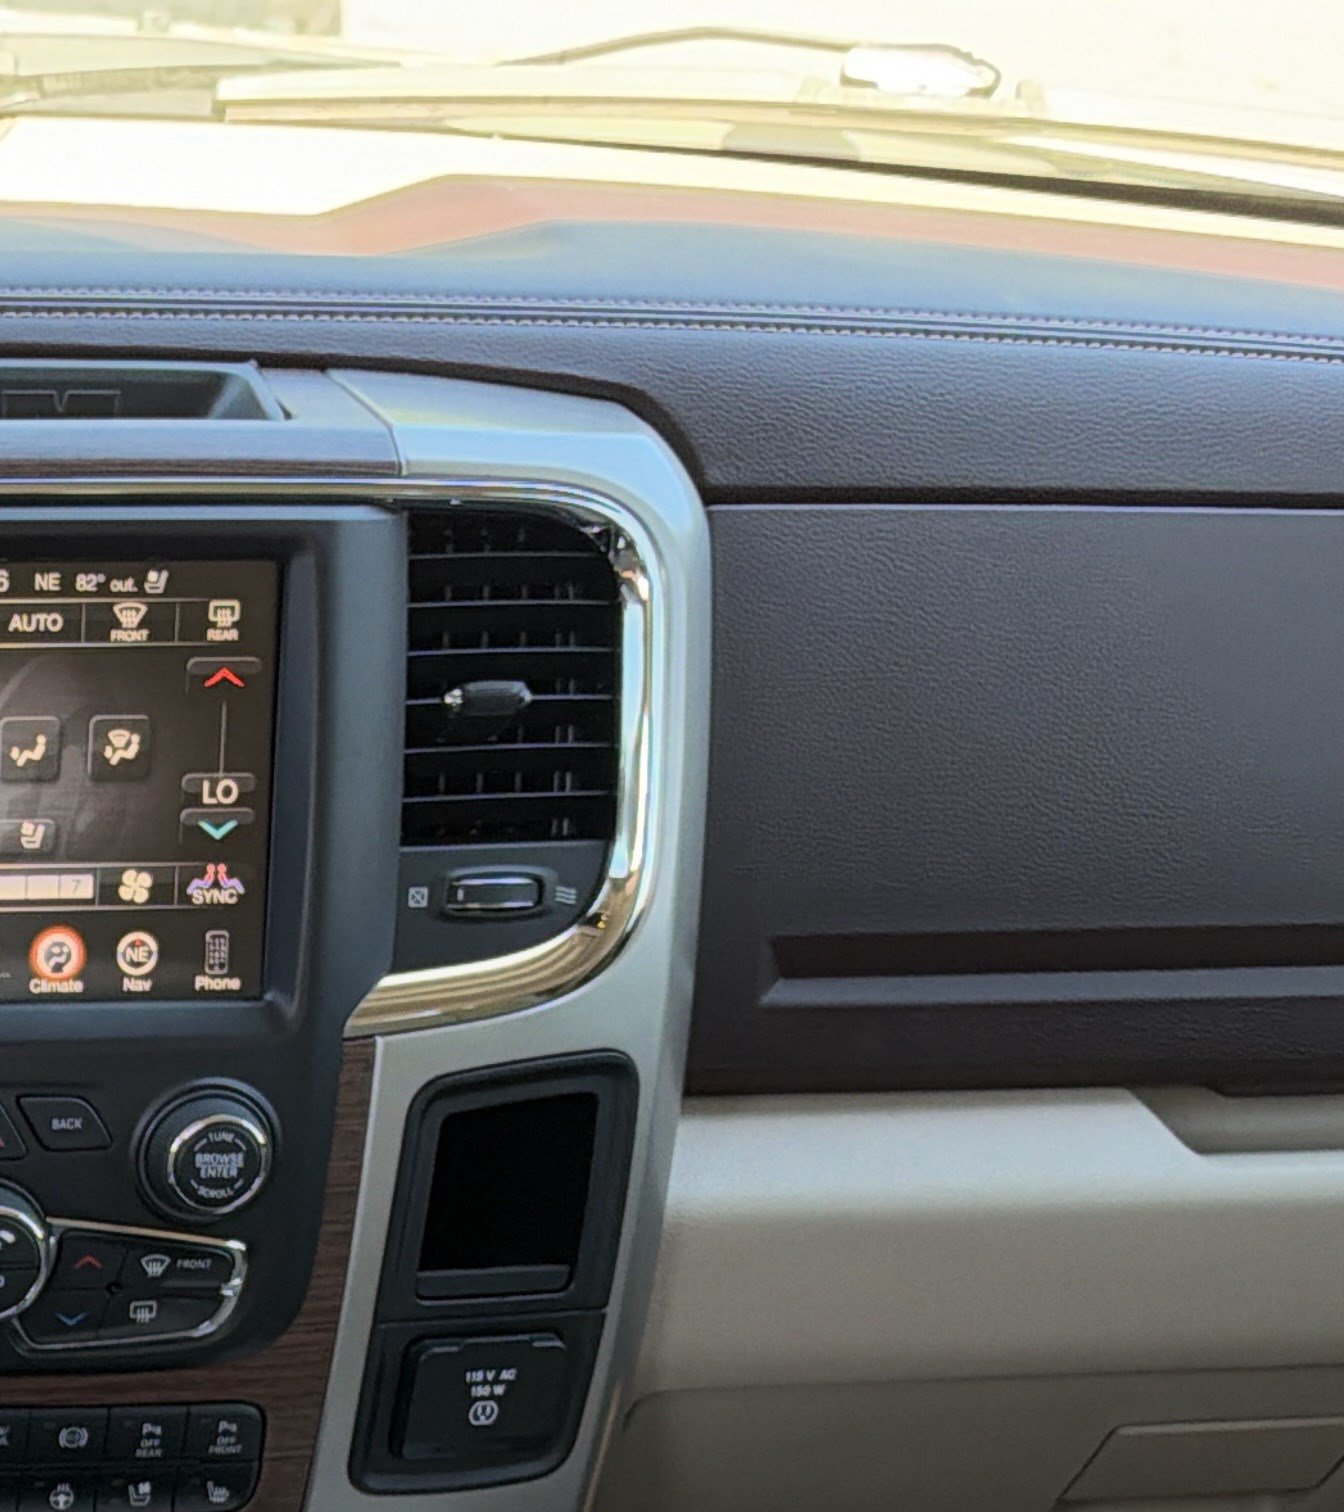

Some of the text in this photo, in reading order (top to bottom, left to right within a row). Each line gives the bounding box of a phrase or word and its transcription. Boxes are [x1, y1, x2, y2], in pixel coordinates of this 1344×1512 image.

[34, 572, 62, 591] NE
[75, 573, 106, 592] 82°
[8, 613, 63, 632] AUTO
[110, 629, 149, 641] FRONT
[206, 628, 239, 641] REAR
[202, 778, 238, 804] LO
[192, 888, 238, 904] SYNC
[125, 947, 149, 963] NE
[29, 978, 84, 994] Climate
[122, 977, 153, 992] Nav
[194, 975, 241, 992] Phone
[52, 1118, 82, 1130] BACK
[195, 1153, 244, 1167] BROWSE
[200, 1166, 239, 1178] ENTER
